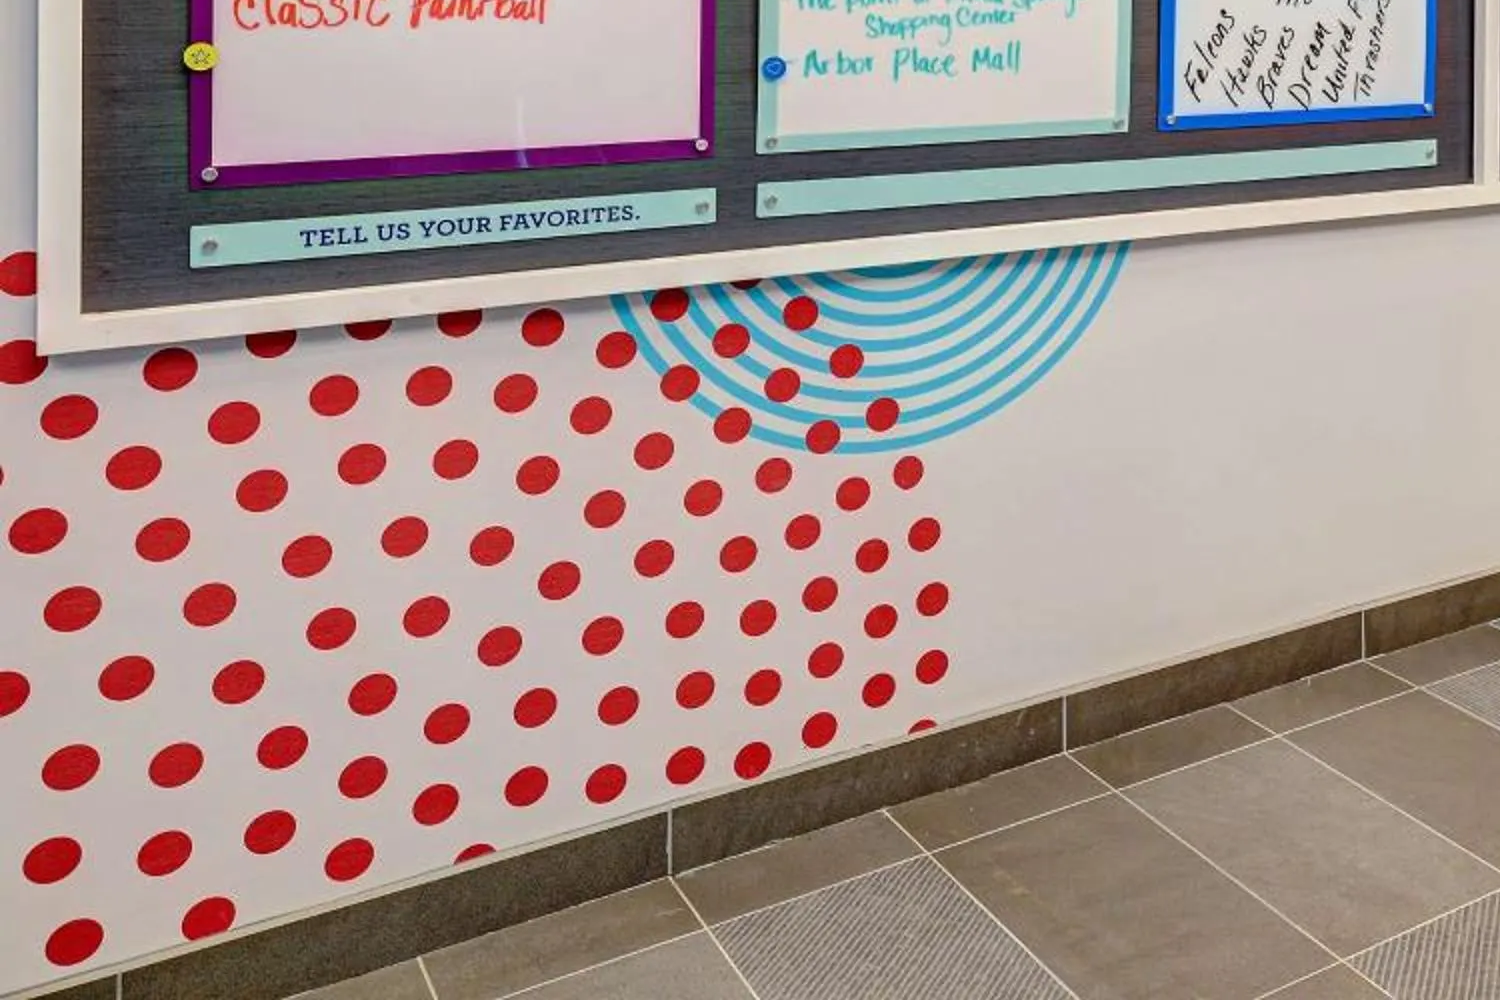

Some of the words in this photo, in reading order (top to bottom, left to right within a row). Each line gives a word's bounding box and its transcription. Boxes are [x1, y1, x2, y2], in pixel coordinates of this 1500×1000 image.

[865, 12, 953, 47] Shopping
[956, 6, 1016, 28] Center
[803, 49, 874, 79] Arbor
[893, 48, 958, 84] Place
[972, 39, 1022, 75] Mall
[1256, 25, 1296, 110] Braves
[1287, 20, 1333, 112] Dream
[300, 225, 369, 249] TELL
[378, 222, 411, 242] US
[417, 216, 493, 239] YOUR
[499, 205, 641, 232] FAVORITES.
